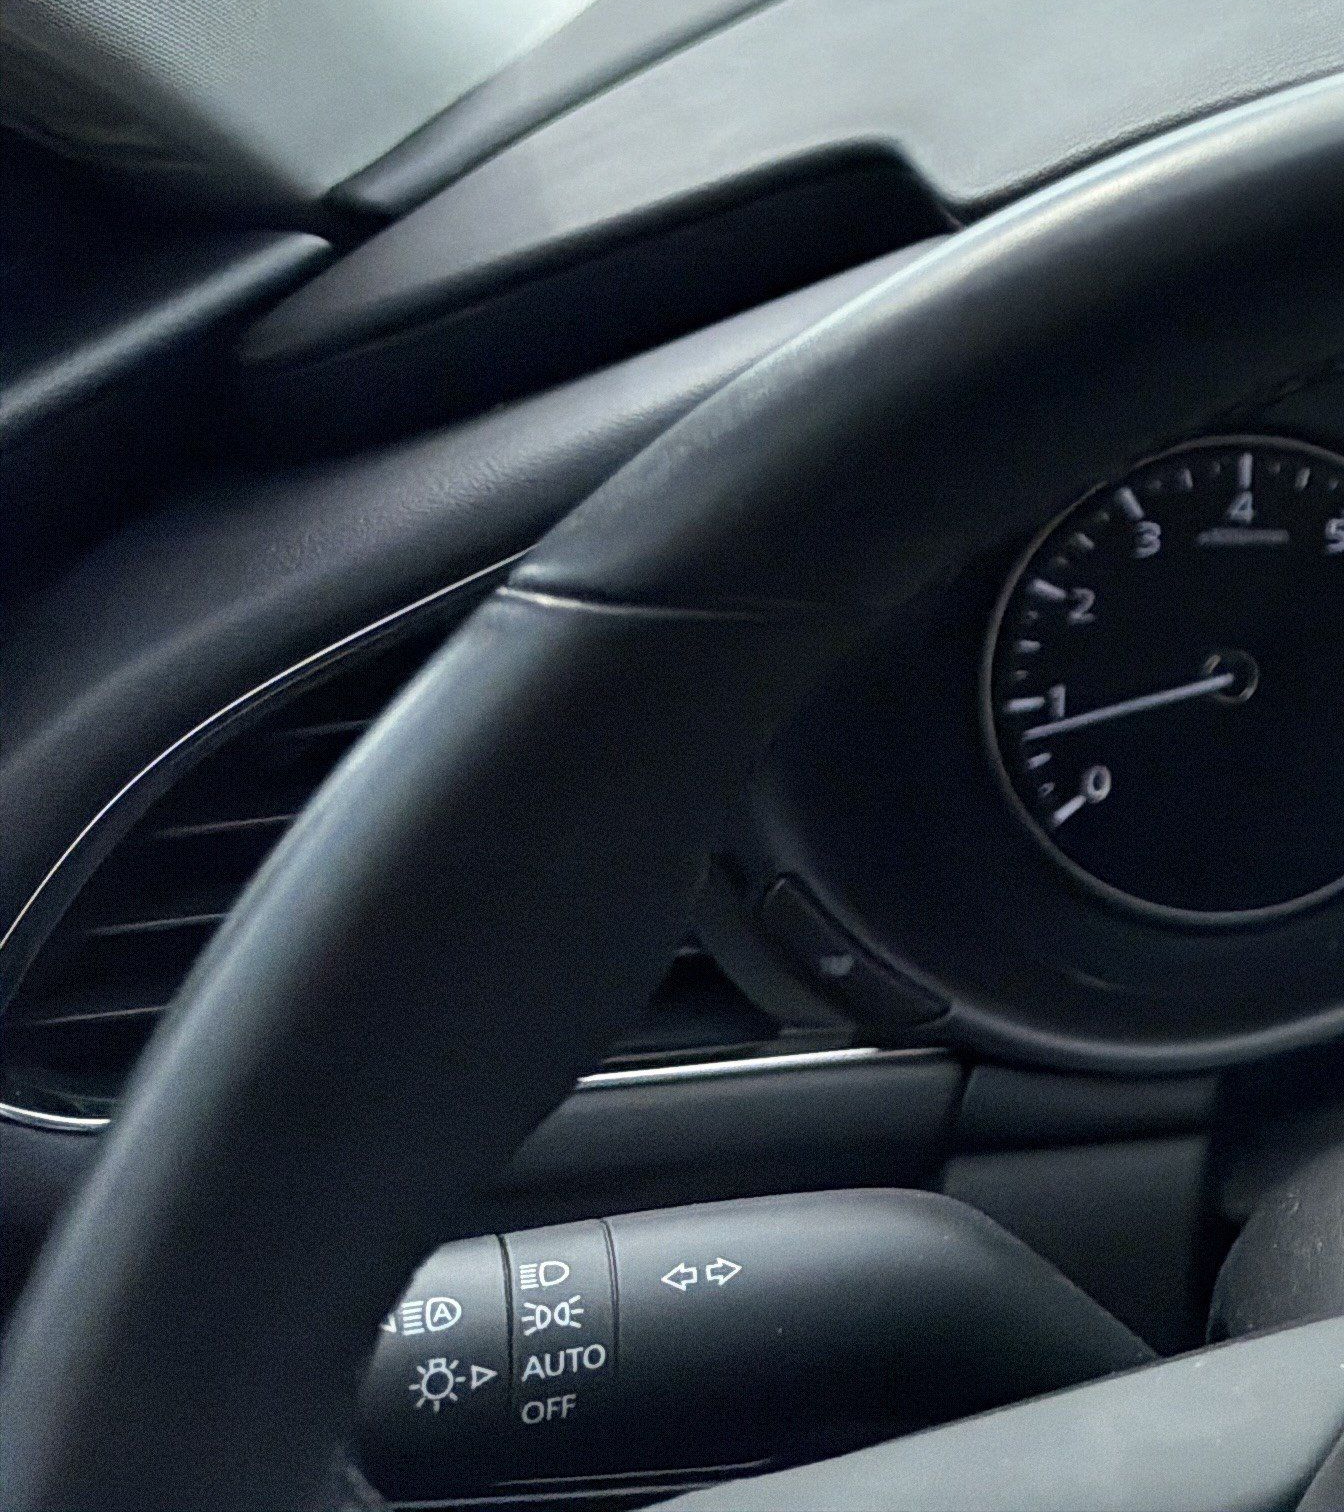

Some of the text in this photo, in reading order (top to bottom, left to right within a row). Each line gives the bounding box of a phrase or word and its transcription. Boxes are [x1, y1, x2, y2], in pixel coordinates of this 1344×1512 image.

[1229, 491, 1254, 524] 4
[1135, 522, 1162, 559] 3
[1069, 589, 1095, 624] 2
[1050, 685, 1066, 717] 1
[1087, 766, 1112, 804] 0
[521, 1344, 607, 1382] AUTO
[521, 1394, 577, 1425] OFF
